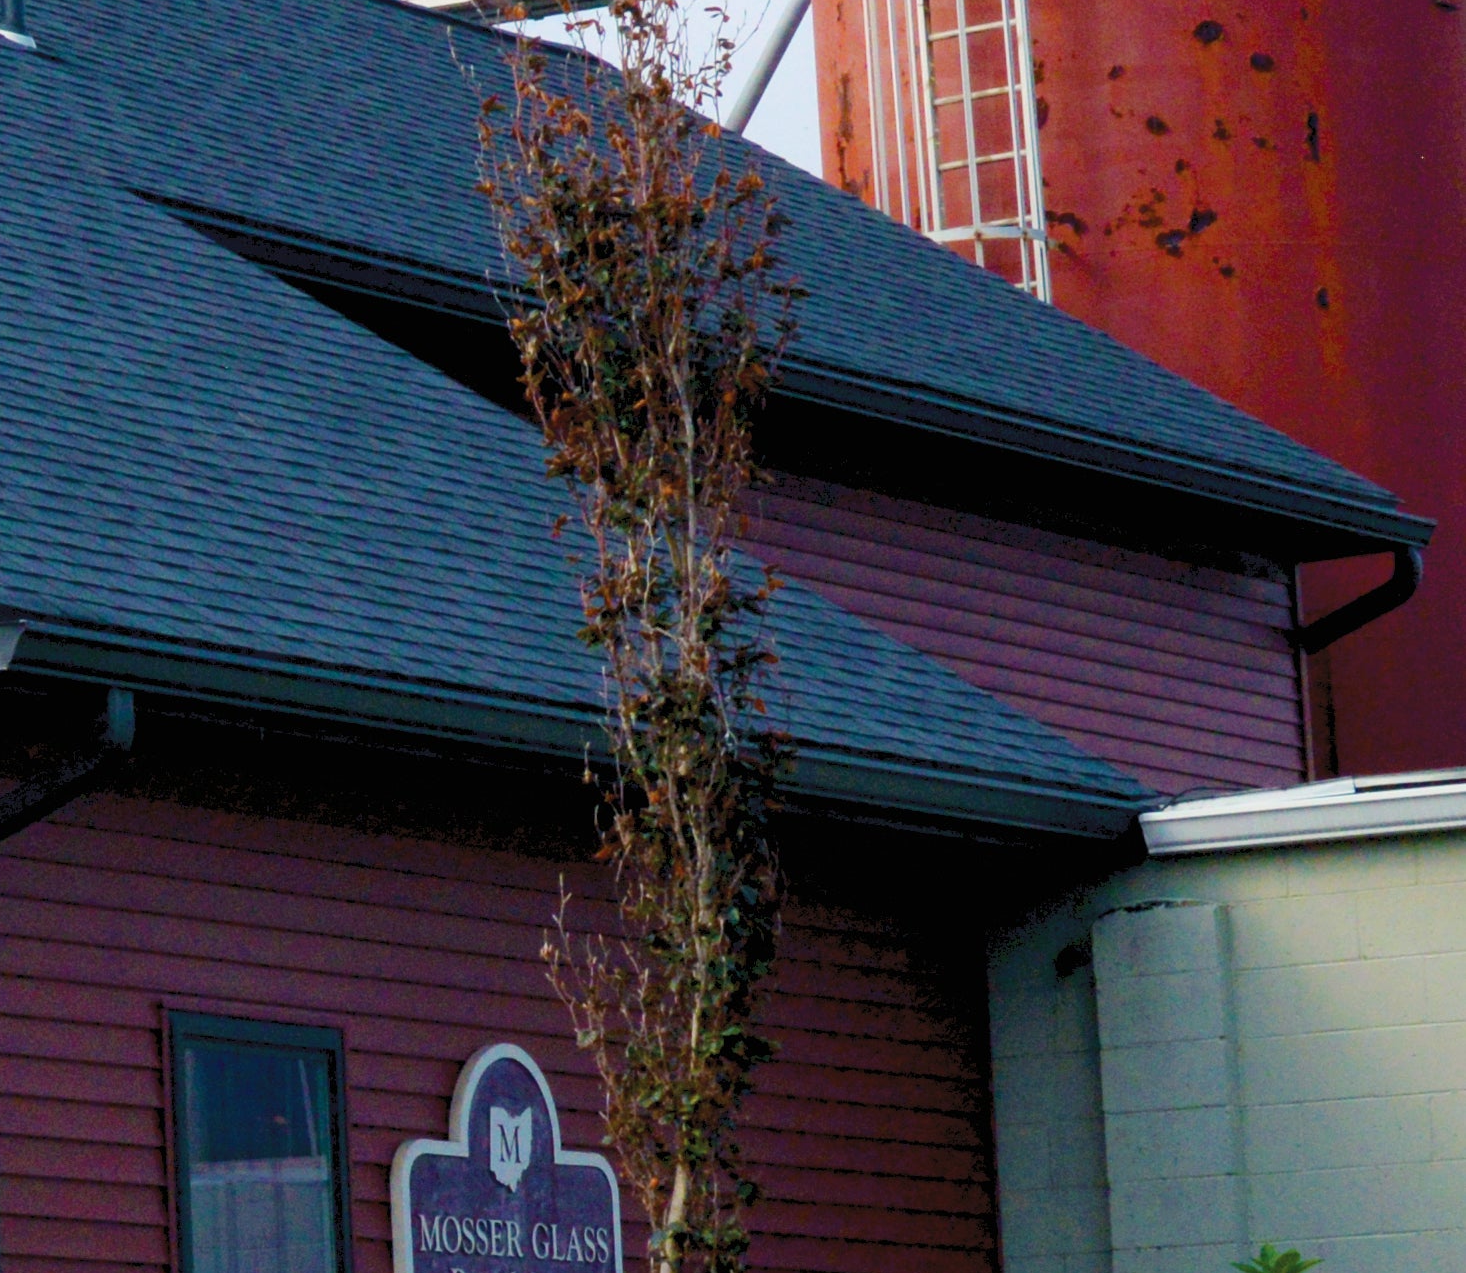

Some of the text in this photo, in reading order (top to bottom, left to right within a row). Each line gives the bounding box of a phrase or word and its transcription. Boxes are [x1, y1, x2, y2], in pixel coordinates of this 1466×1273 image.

[499, 1123, 521, 1164] M
[419, 1214, 609, 1263] MOSSER GLASS
